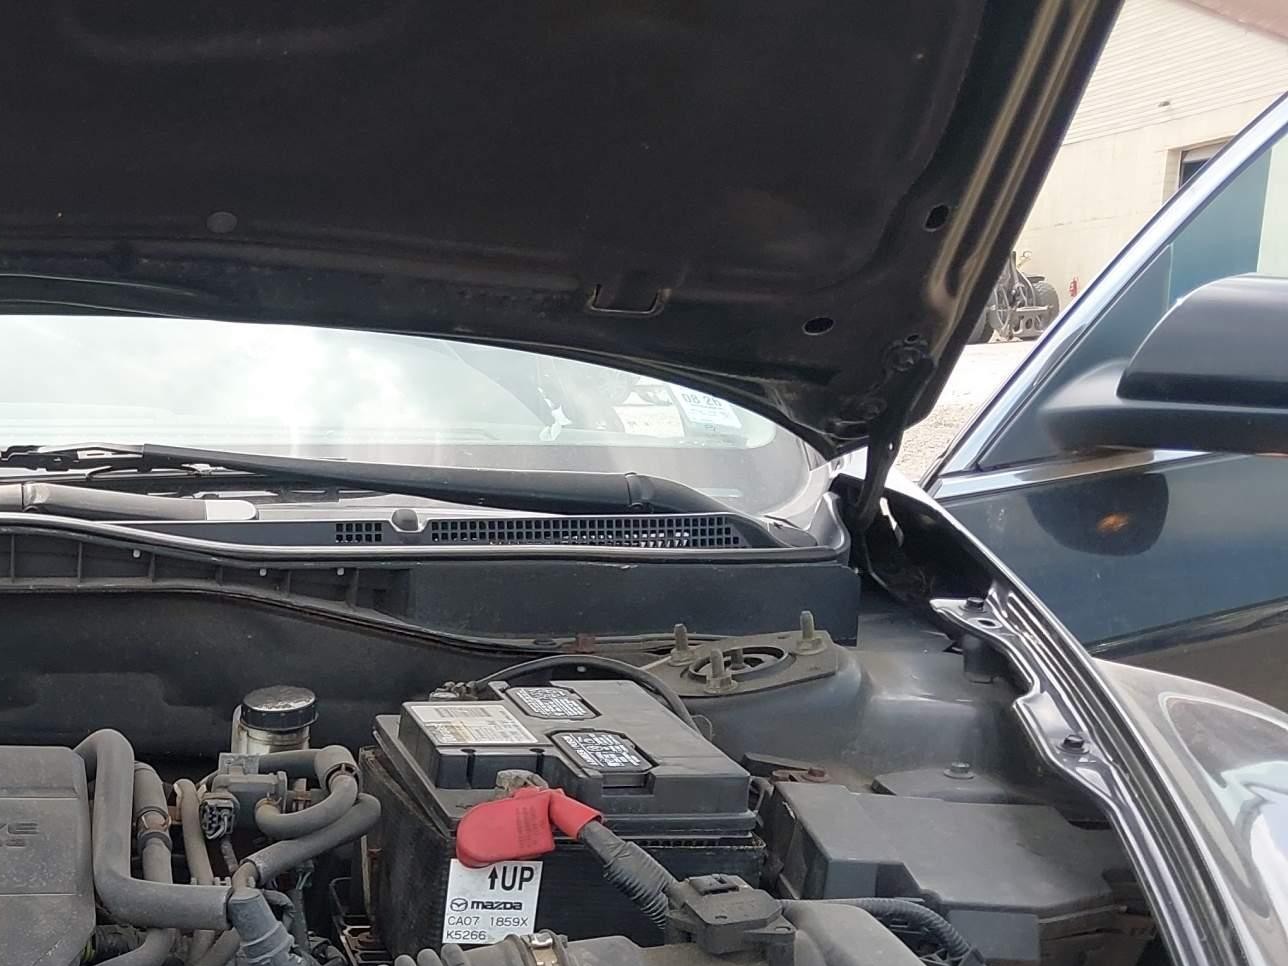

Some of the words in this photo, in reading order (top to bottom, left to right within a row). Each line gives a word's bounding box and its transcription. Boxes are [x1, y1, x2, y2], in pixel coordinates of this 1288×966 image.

[501, 865, 535, 891] UP
[470, 900, 523, 911] mazda
[447, 916, 481, 926] CA07
[490, 917, 529, 927] 1859X
[446, 930, 487, 940] K5266
